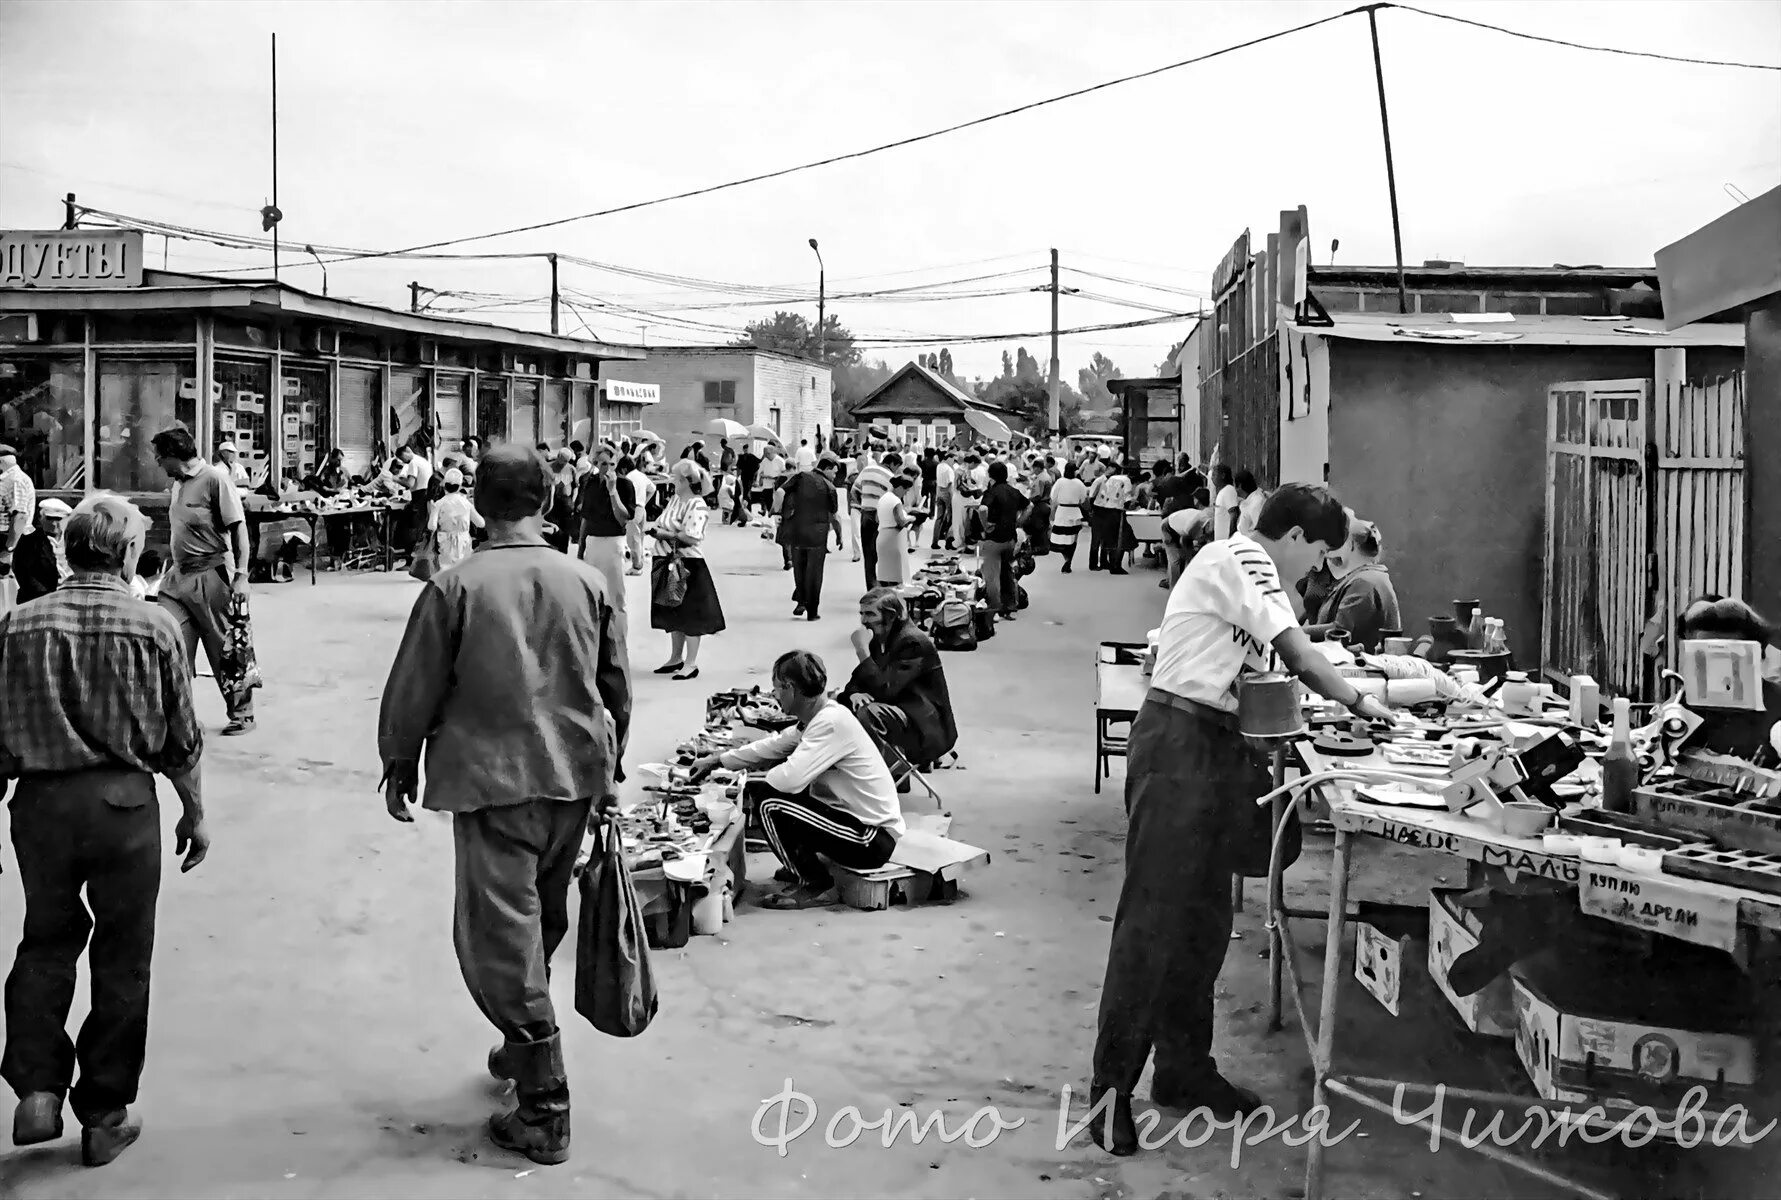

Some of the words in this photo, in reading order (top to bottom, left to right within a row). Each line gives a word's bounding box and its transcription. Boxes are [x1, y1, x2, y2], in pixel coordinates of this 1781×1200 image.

[0, 242, 126, 282] ДУКТЫ
[1589, 872, 1641, 896] КУПЛЮ
[1639, 901, 1699, 927] ДРЕЛИ
